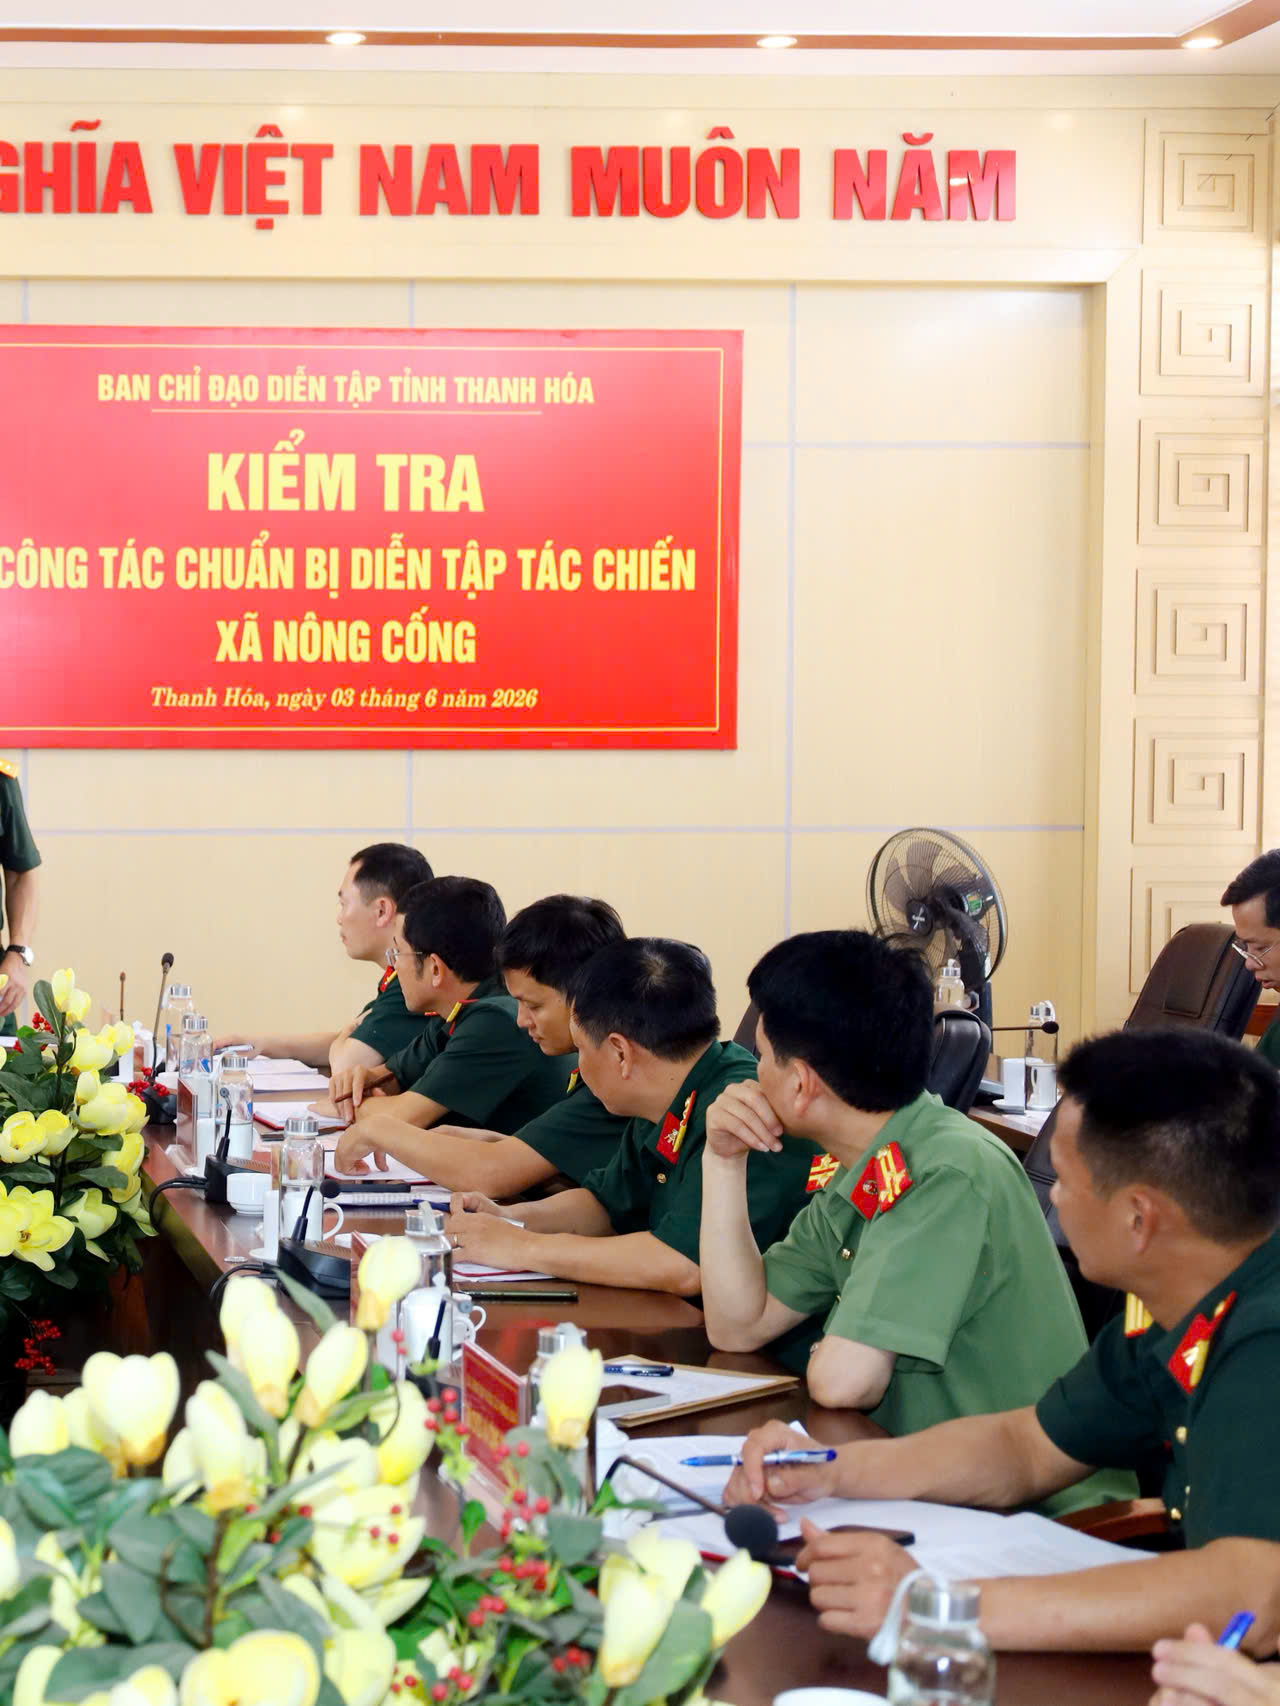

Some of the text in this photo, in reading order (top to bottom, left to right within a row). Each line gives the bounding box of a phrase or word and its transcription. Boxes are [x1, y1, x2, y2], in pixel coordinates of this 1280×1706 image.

[172, 124, 334, 230] VIỆT
[358, 143, 540, 216] NAM
[570, 126, 800, 219] MUÔN
[832, 132, 1016, 221] NĂM
[97, 366, 595, 408] BAN CHỈ ĐẠO DIỄN TẬP TỈNH THANH HÓA
[207, 428, 485, 512] KIỂM TRA
[98, 538, 165, 589] TÁC
[175, 530, 295, 590] CHUẨN
[305, 547, 340, 599] BỊ
[350, 532, 432, 591] DIỄN
[441, 539, 508, 600] TẬP
[516, 539, 582, 591] TÁC
[592, 534, 696, 592] CHIẾN
[215, 605, 477, 664] XÃ NÔNG CỐNG
[150, 686, 539, 712] Thanh Hóa, ngày 03 tháng 6 năm 2026
